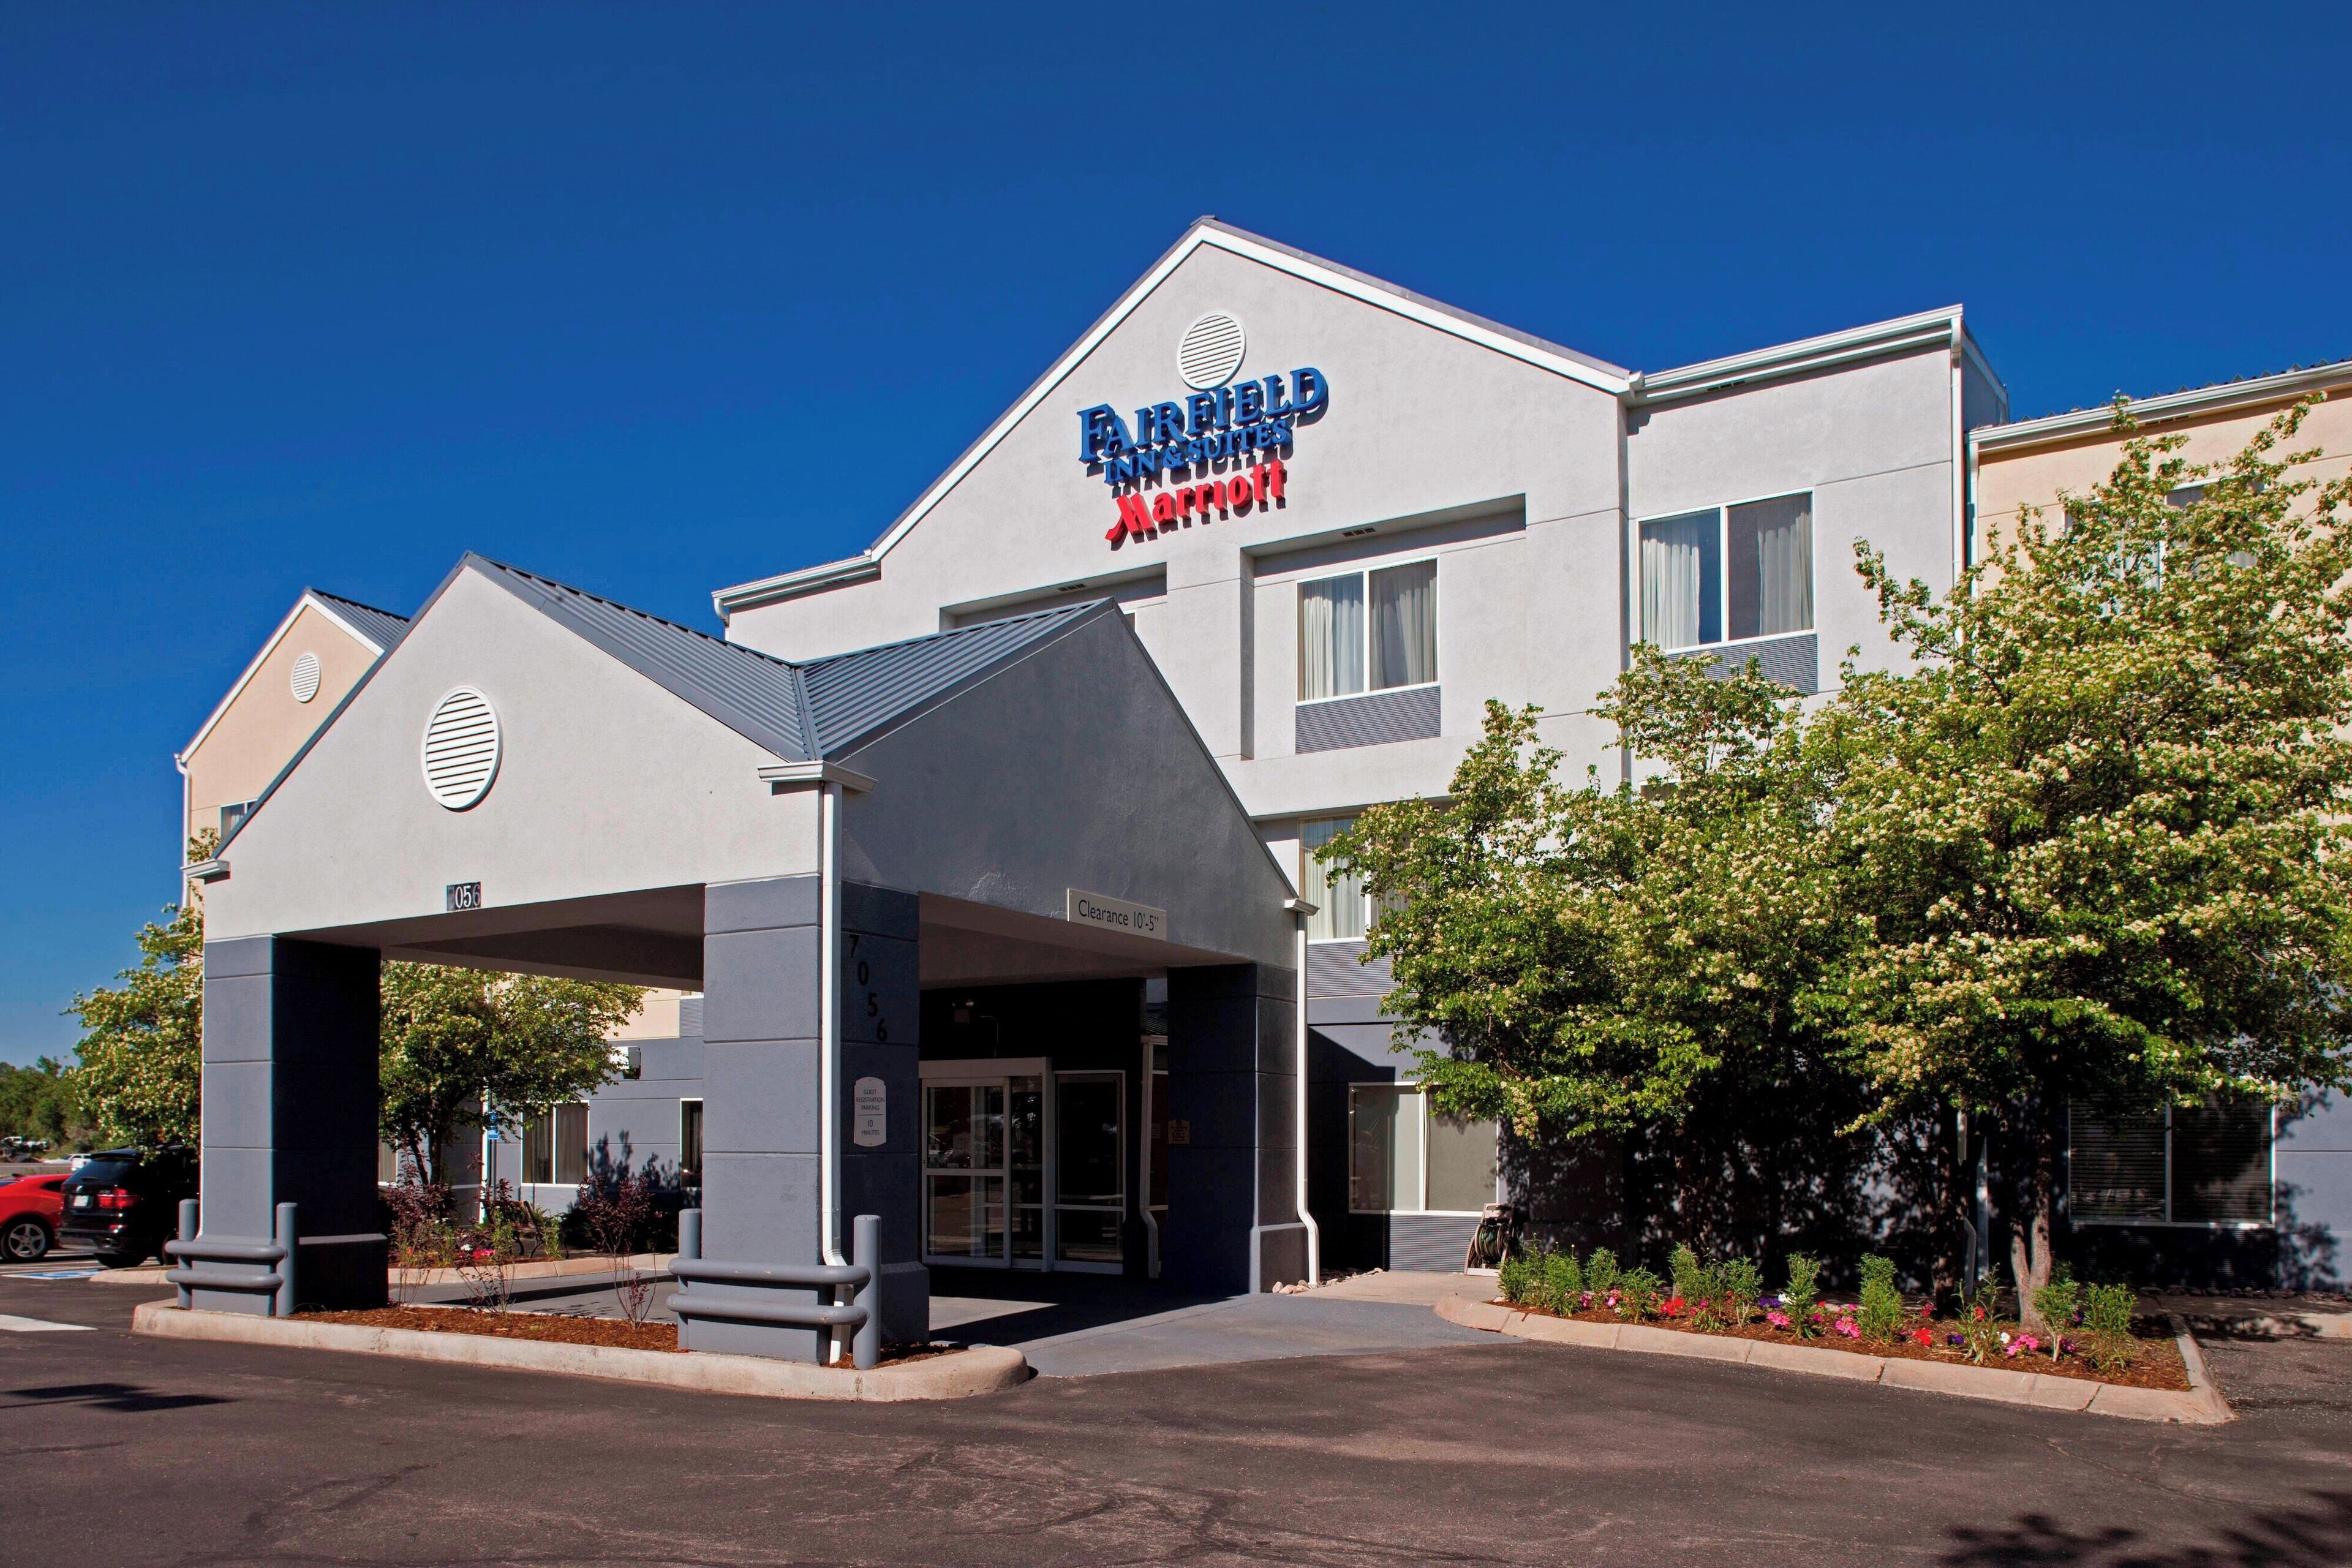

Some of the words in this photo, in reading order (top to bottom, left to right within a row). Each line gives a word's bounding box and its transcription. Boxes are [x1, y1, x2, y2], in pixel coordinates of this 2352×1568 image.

[1077, 367, 1328, 464] FAIRFIELD
[1103, 450, 1158, 485] INN
[1163, 445, 1185, 471] &
[1188, 418, 1292, 464] SUITES
[1104, 459, 1287, 541] Marriott
[1078, 899, 1129, 925] Clearance
[867, 1119, 873, 1128] 10
